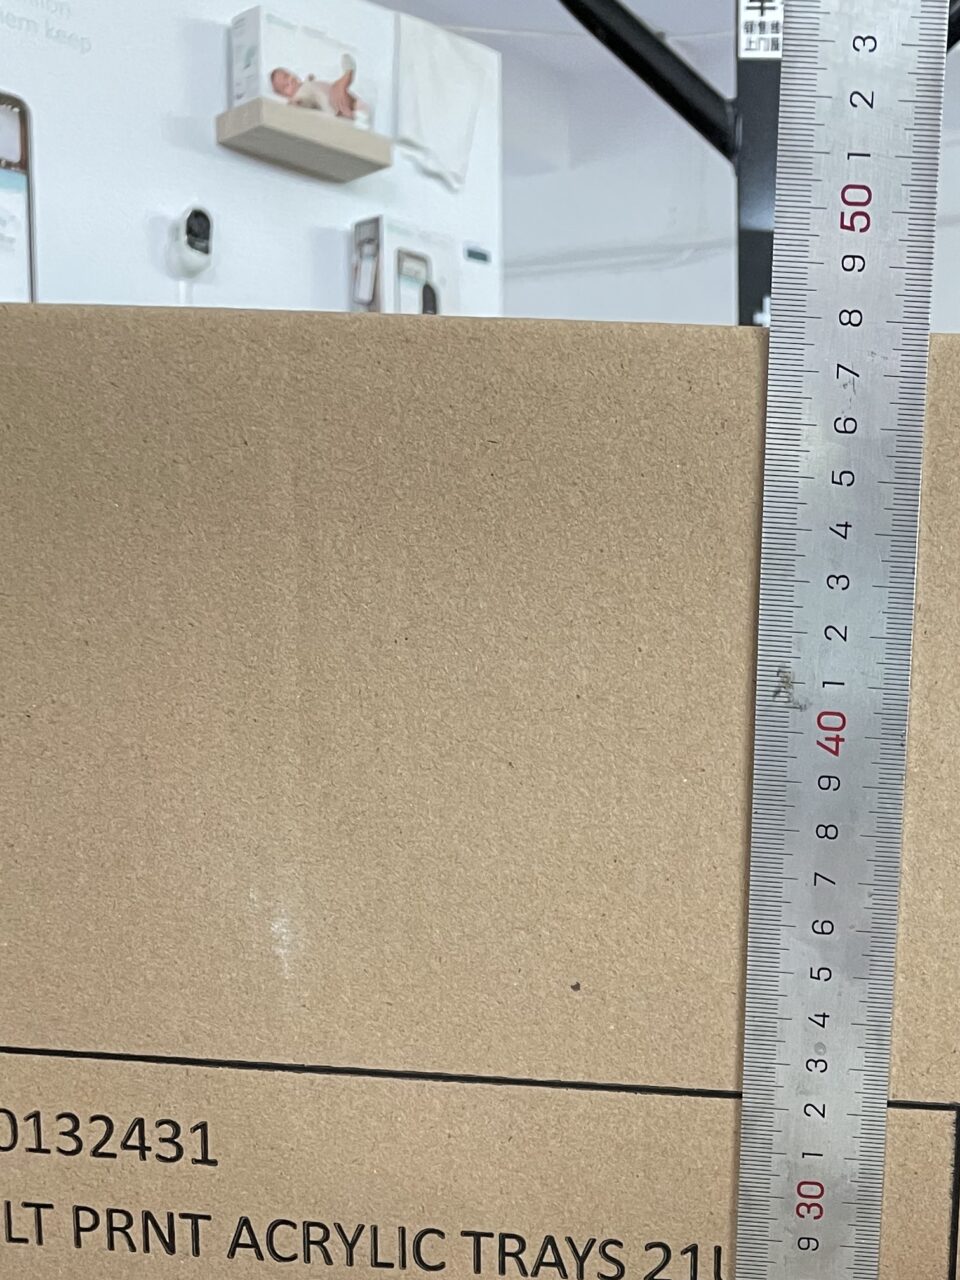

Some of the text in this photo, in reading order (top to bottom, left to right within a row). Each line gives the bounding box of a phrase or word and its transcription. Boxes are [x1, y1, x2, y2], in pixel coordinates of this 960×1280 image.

[853, 36, 877, 52] 3
[850, 91, 874, 109] 2
[840, 184, 872, 232] 50
[842, 255, 865, 272] 9
[839, 310, 862, 327] 8
[837, 364, 859, 379] 7
[834, 417, 857, 434] 6
[832, 471, 855, 486] 5
[829, 521, 852, 539] 4
[827, 575, 849, 590] 3
[825, 626, 847, 641] 2
[817, 711, 846, 757] 40
[818, 775, 840, 791] 9
[816, 824, 838, 839] 8
[814, 872, 836, 886] 7
[812, 920, 834, 935] 6
[810, 967, 832, 981] 5
[808, 1012, 829, 1028] 4
[806, 1058, 827, 1072] 3
[804, 1104, 825, 1118] 2
[796, 1181, 824, 1220] 30
[72, 1205, 212, 1257] PRNT
[227, 1216, 446, 1272] ACRYLIC
[798, 1237, 819, 1251] 9
